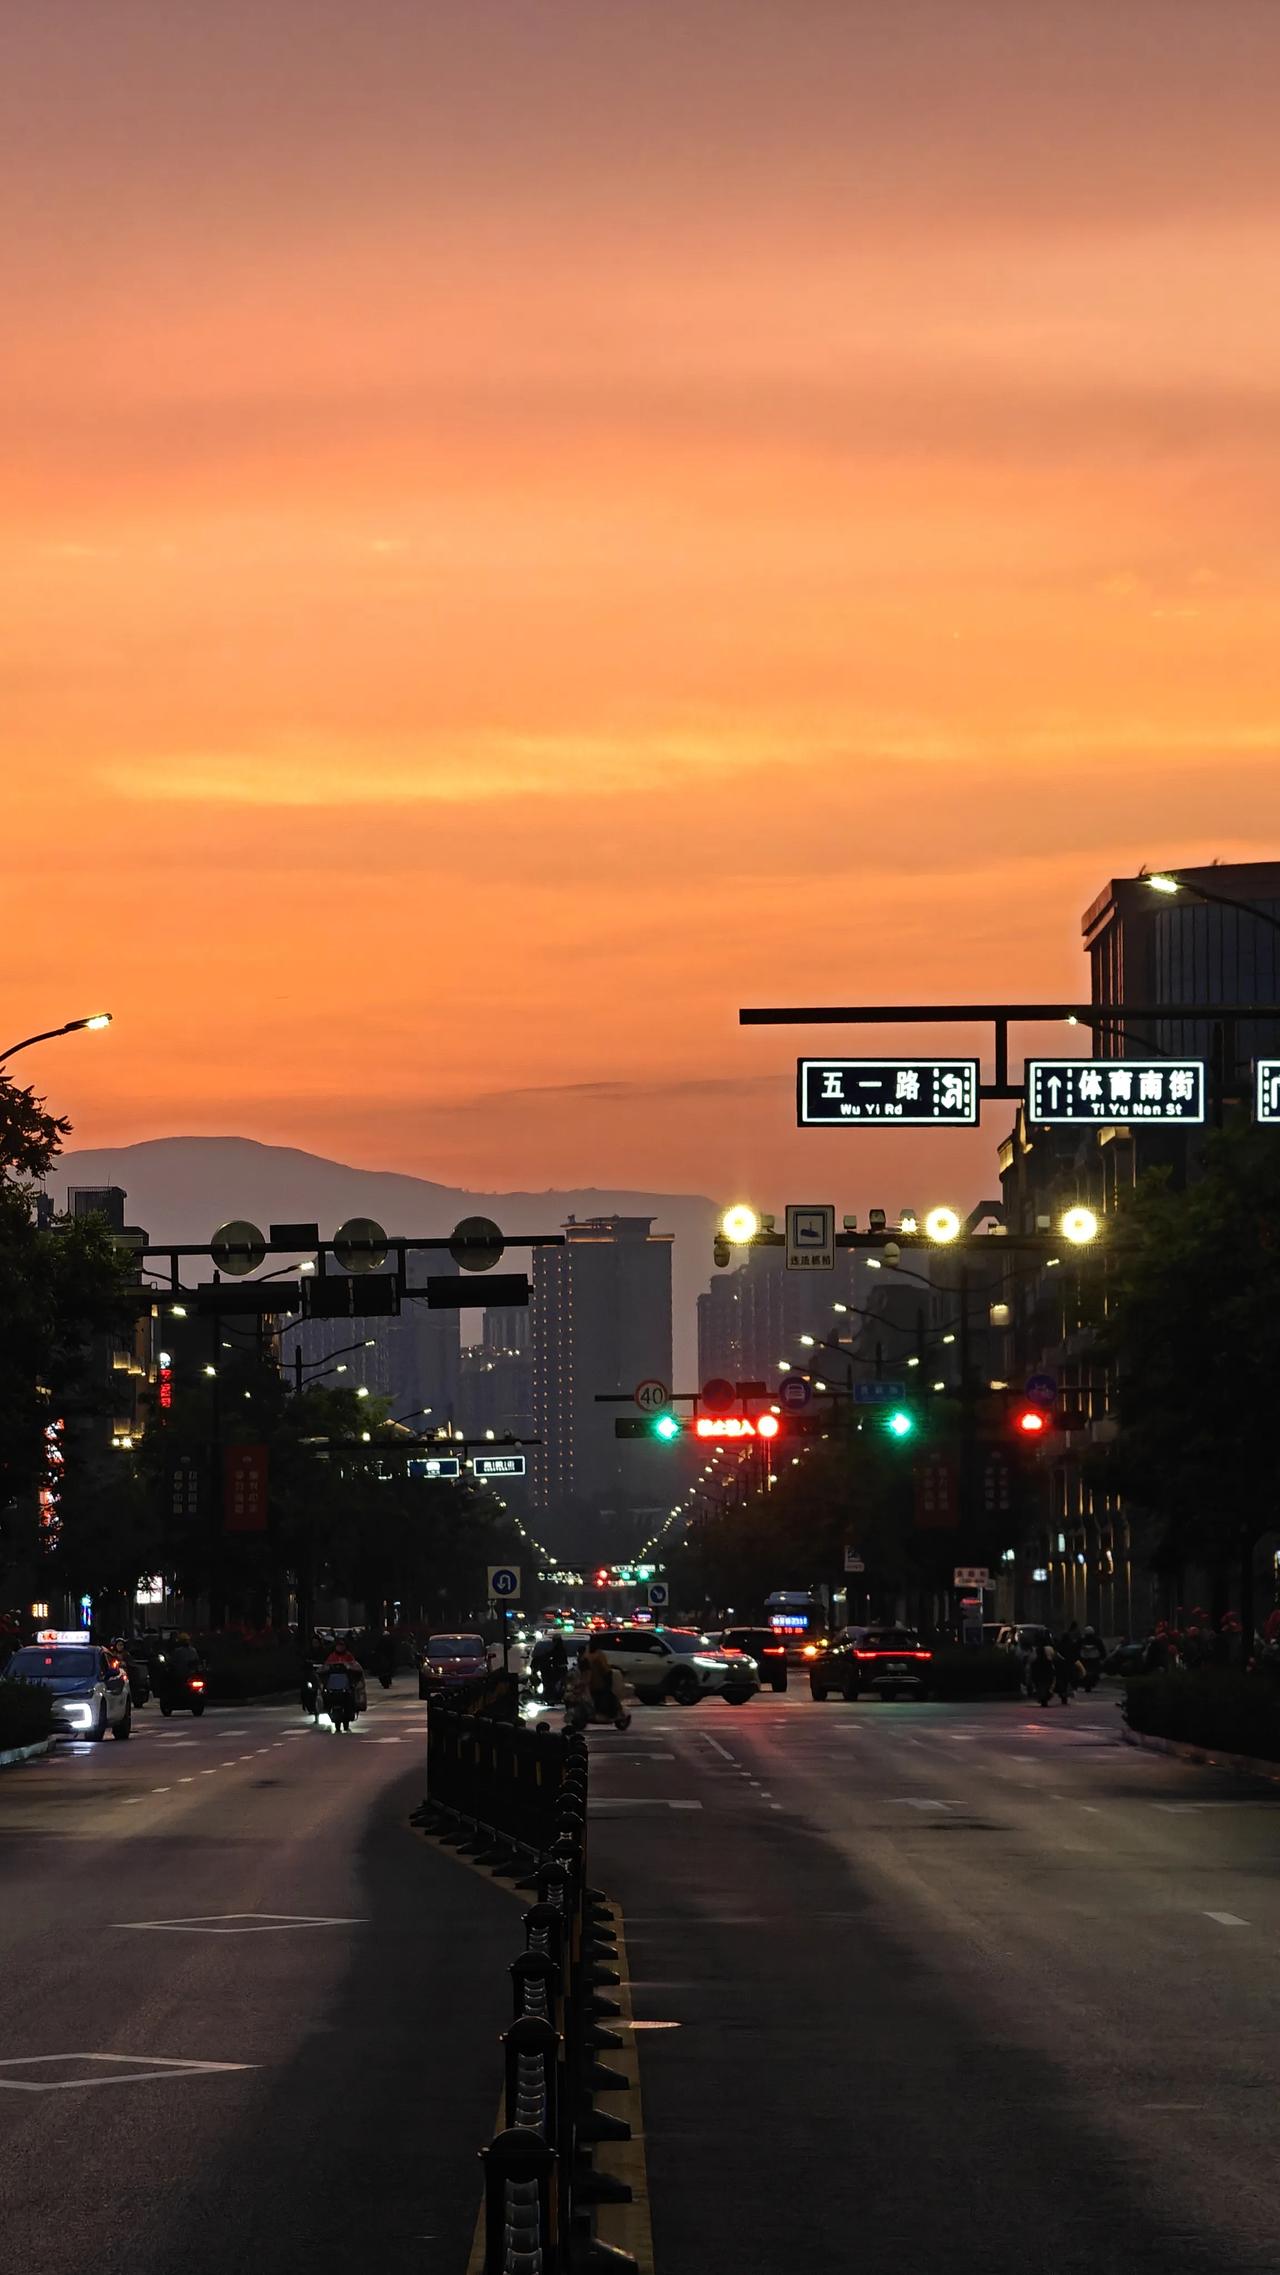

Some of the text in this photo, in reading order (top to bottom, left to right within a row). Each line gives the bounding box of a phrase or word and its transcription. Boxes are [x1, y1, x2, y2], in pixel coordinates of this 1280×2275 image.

[821, 1070, 920, 1100] 五一路
[1078, 1069, 1195, 1101] 体育南街
[840, 1103, 903, 1115] Wu Yi Rd
[1109, 1103, 1129, 1116] Yu
[1133, 1103, 1161, 1116] Nan
[1166, 1103, 1183, 1116] St
[640, 1387, 663, 1404] 40
